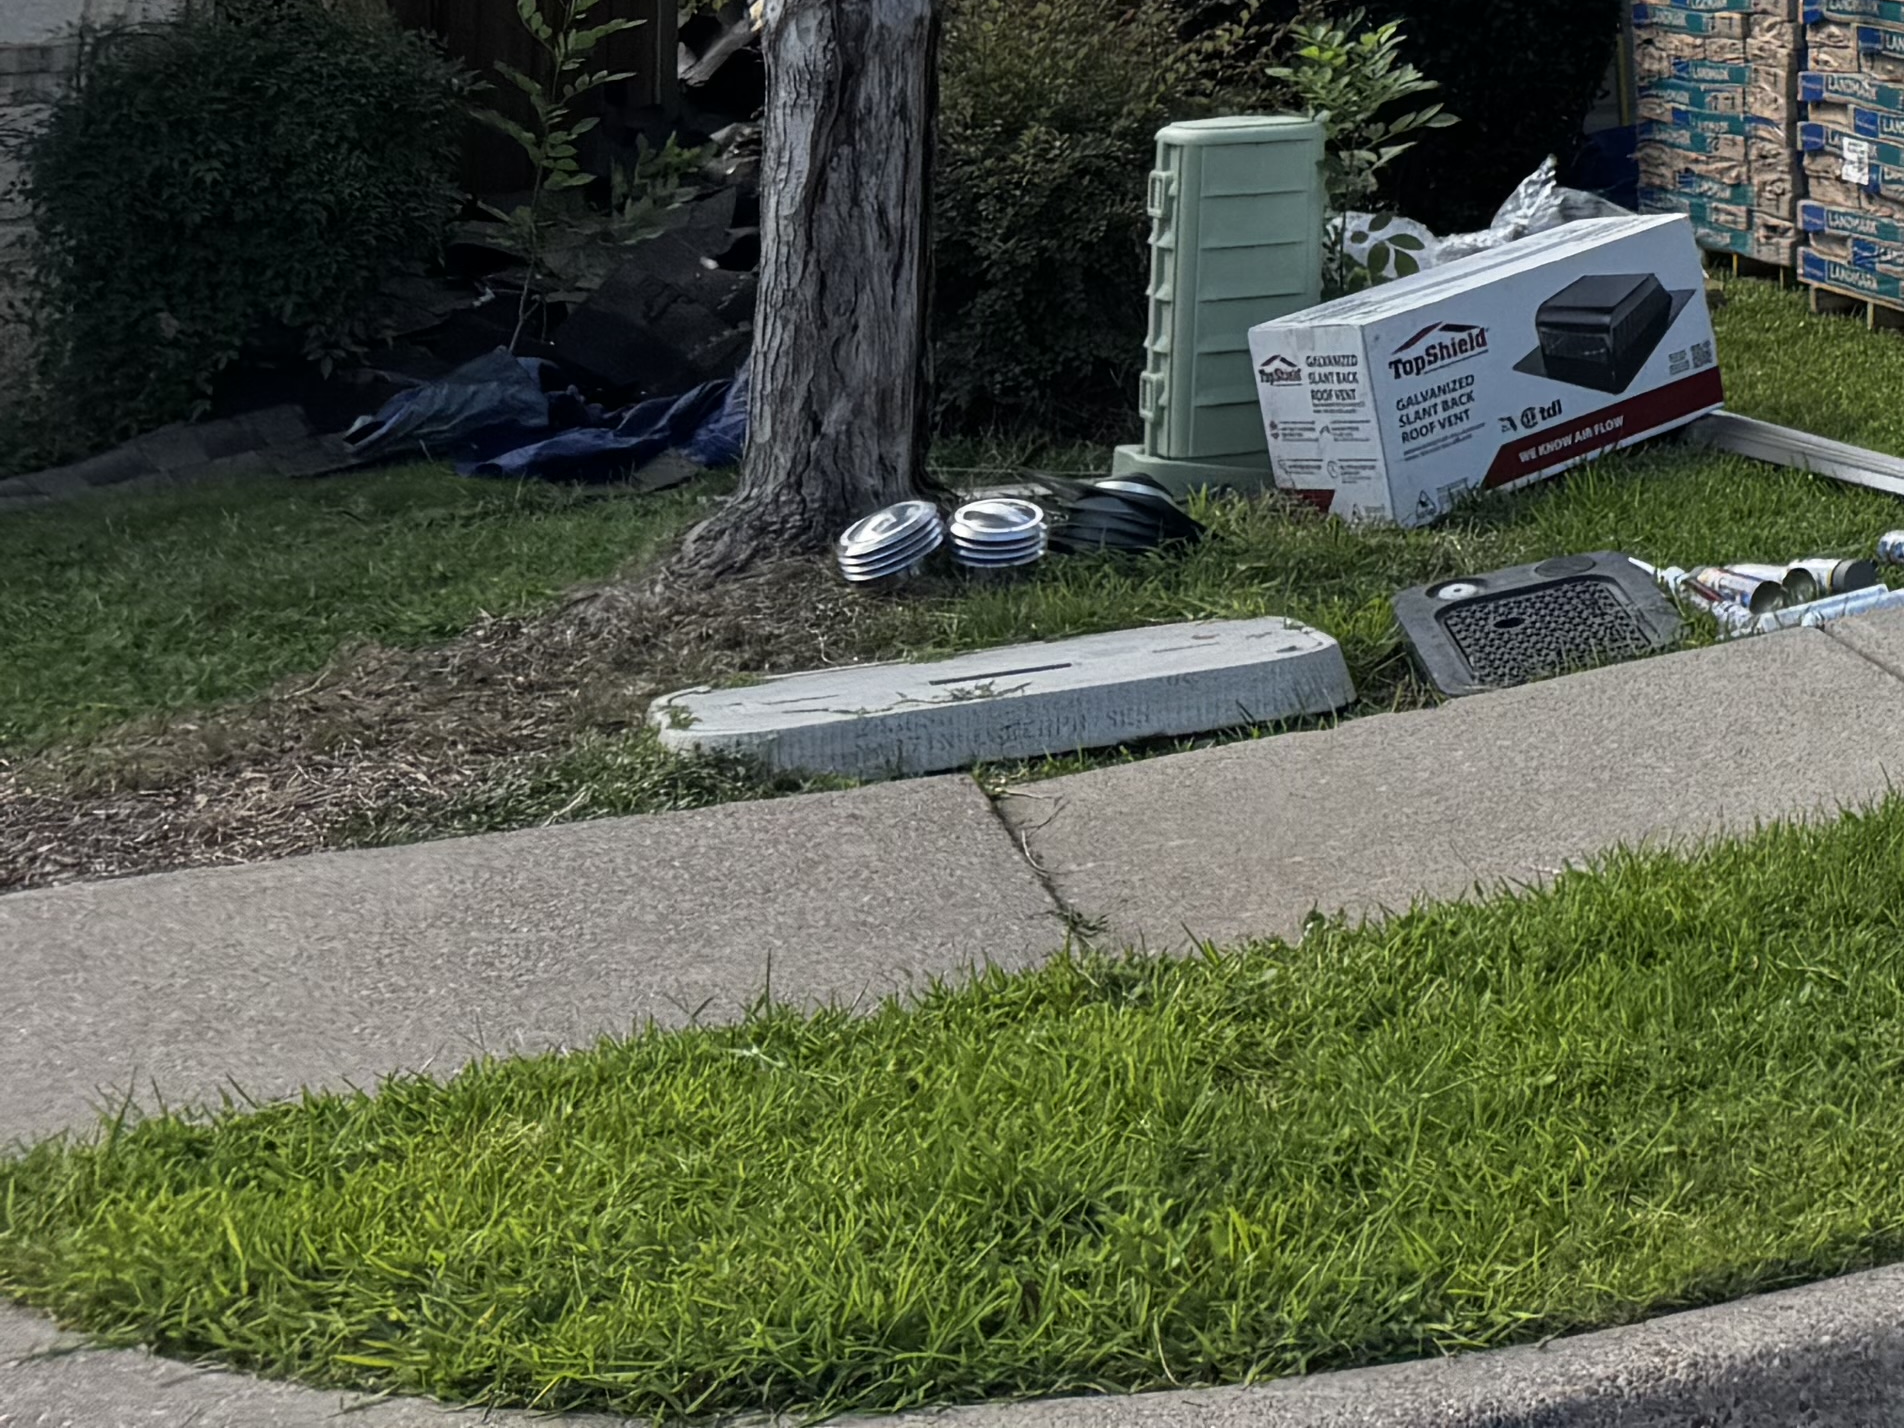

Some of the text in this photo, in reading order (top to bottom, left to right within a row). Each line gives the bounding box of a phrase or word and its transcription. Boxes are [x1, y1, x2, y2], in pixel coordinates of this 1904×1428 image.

[1388, 327, 1487, 379] TopShield
[1396, 374, 1475, 411] GALVANIZED
[1399, 390, 1475, 428] SLANT BACK
[1401, 421, 1436, 444] ROOF
[1438, 408, 1470, 430] VENT
[1518, 447, 1538, 463] WE
[1538, 434, 1573, 456] KNOW
[1594, 415, 1624, 435] FLOW
